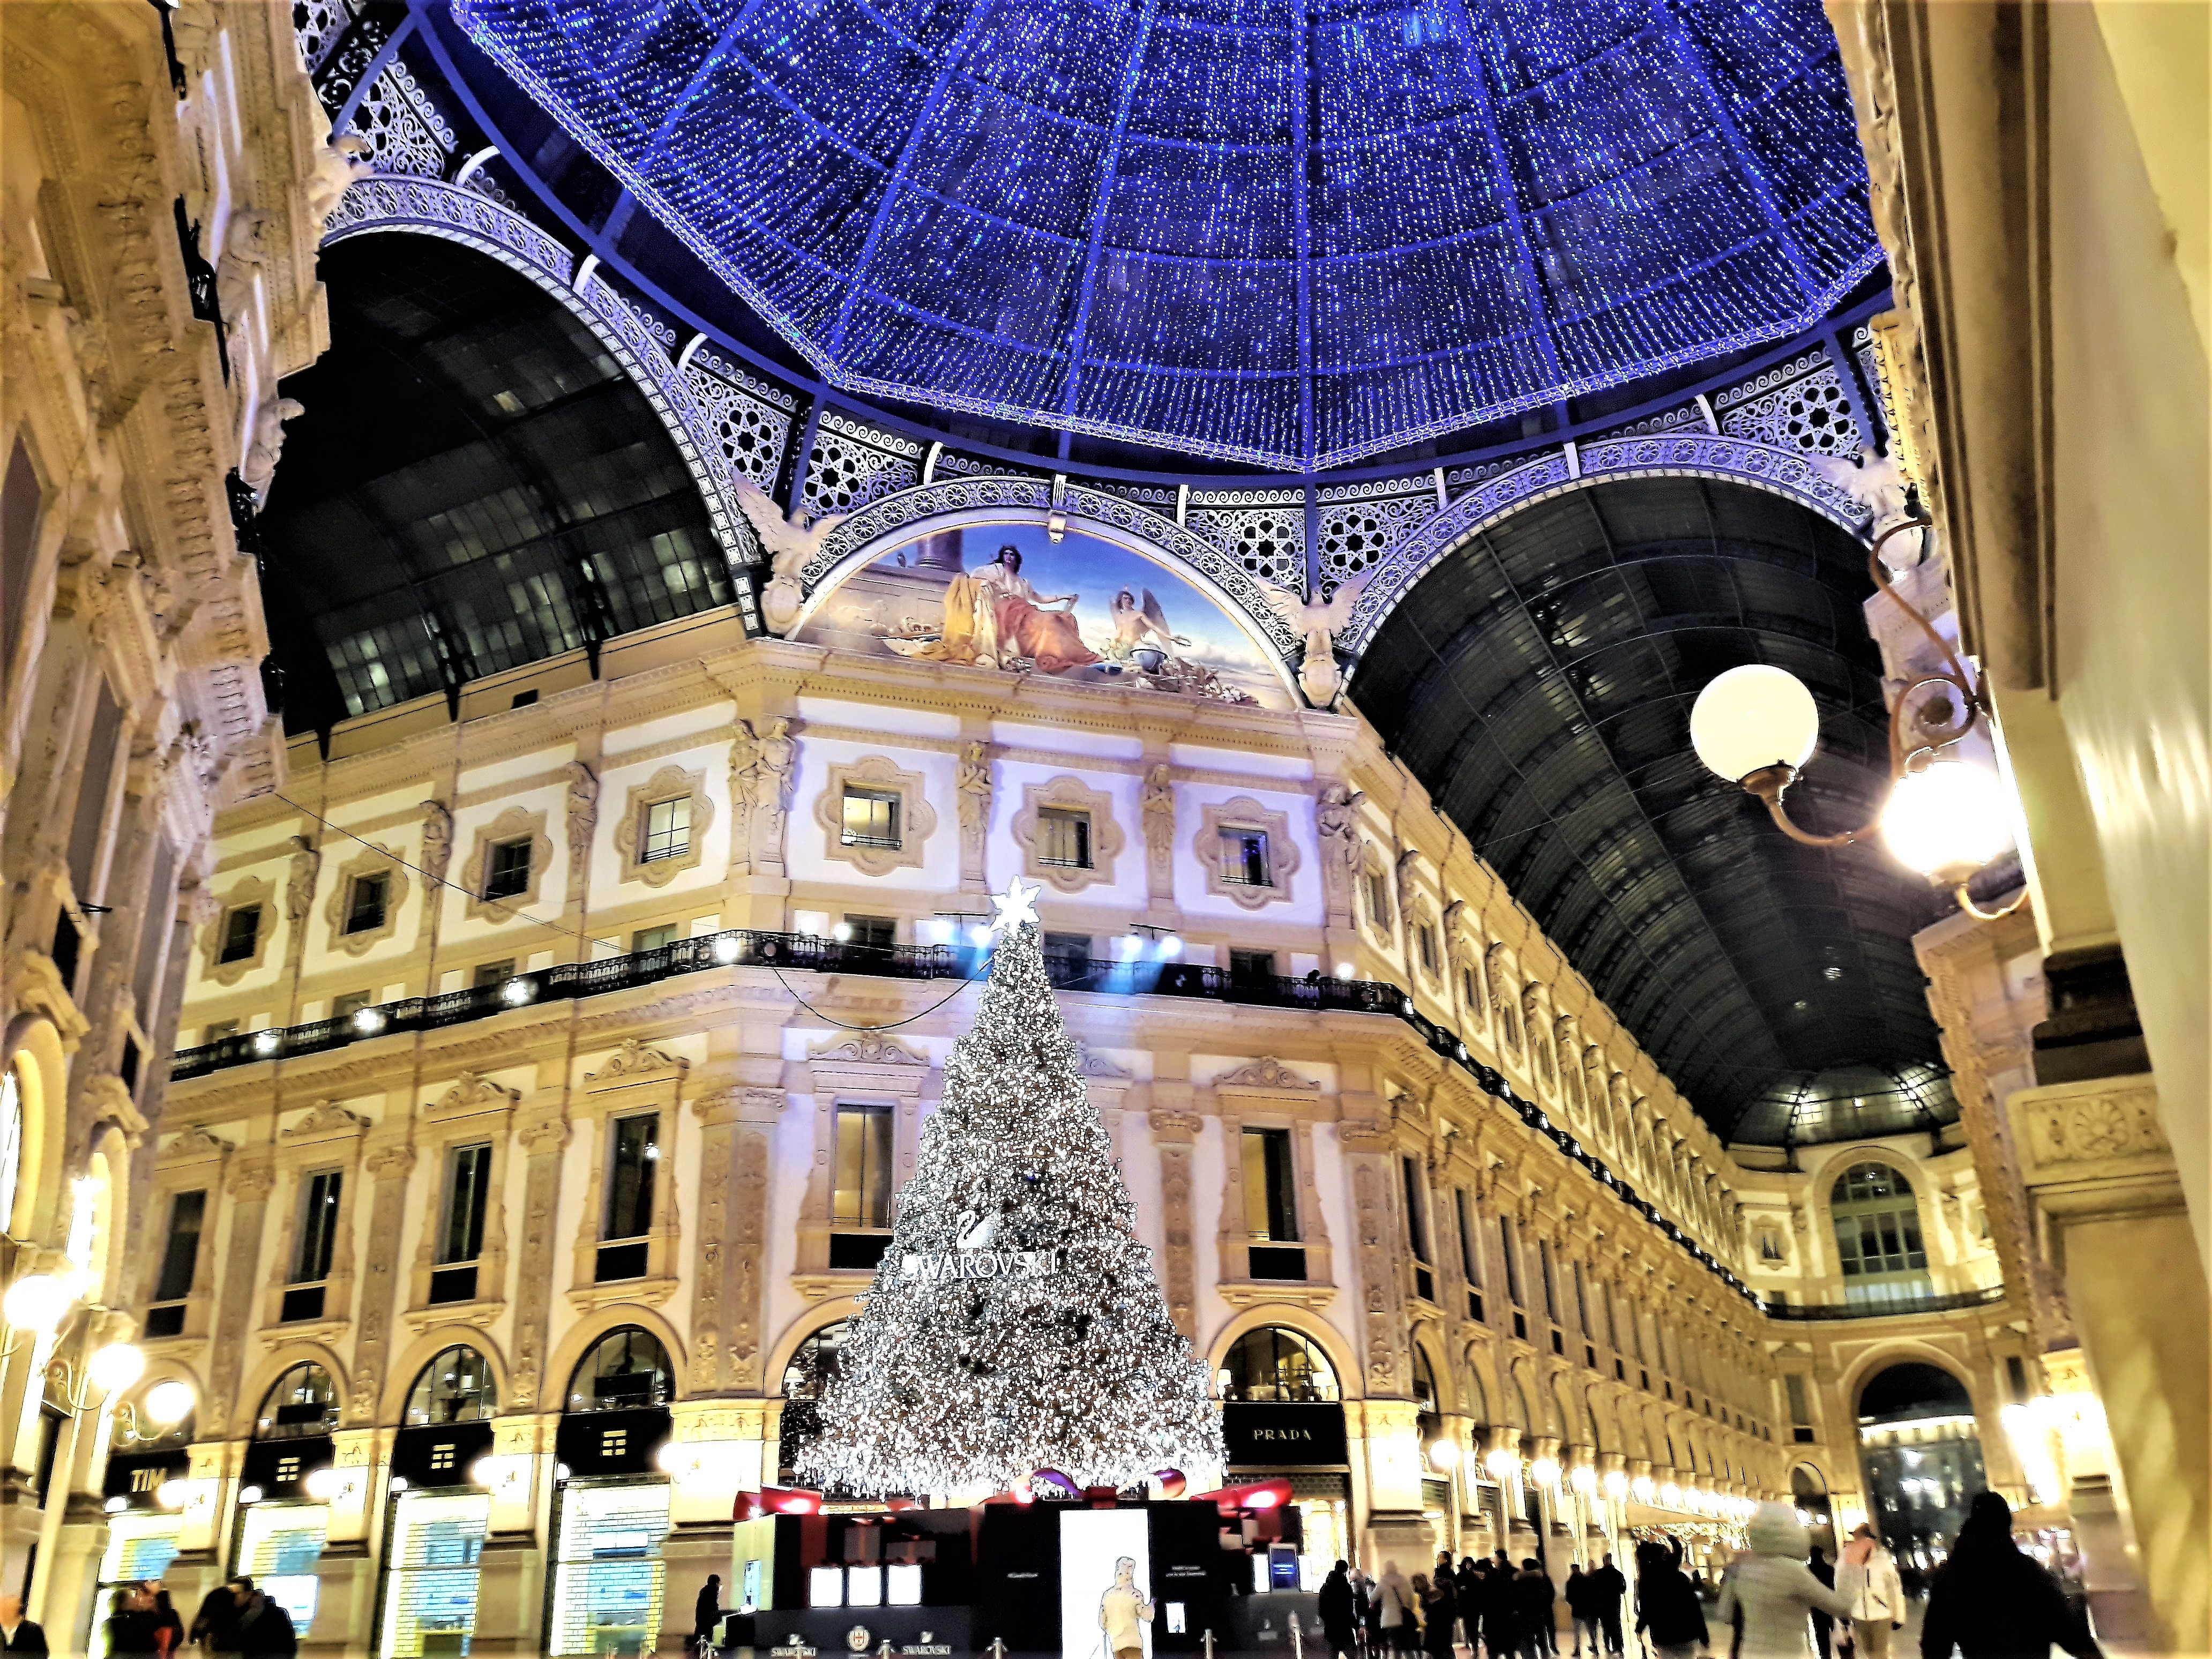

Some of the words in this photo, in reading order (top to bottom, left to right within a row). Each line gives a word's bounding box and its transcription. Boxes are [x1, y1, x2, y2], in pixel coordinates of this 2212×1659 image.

[901, 1251, 1058, 1279] SWAROVSKI
[1254, 1429, 1312, 1440] PRADA
[130, 1468, 167, 1492] TIM
